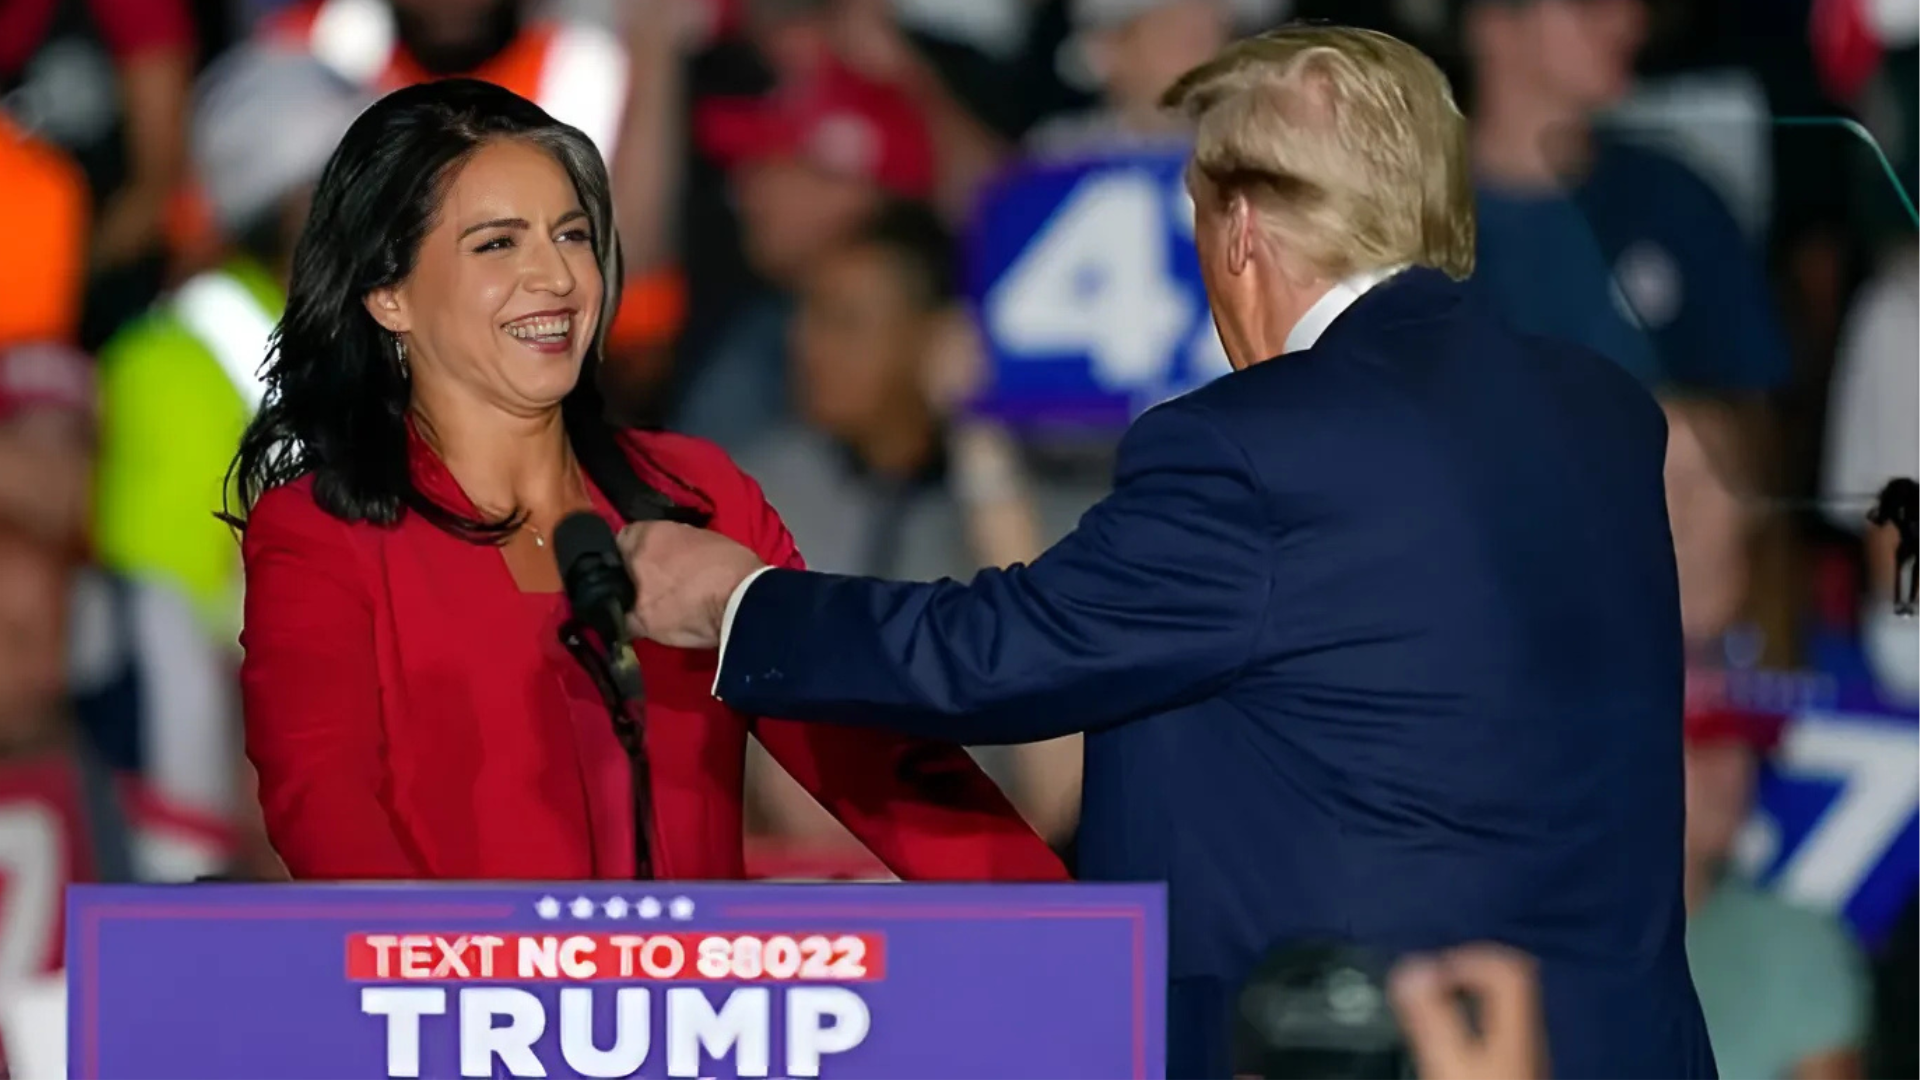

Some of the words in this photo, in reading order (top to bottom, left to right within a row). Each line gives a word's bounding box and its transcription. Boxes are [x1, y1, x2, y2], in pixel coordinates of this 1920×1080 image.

[366, 936, 503, 977] TEXT
[518, 936, 597, 978] NC
[610, 936, 685, 978] TO
[361, 987, 870, 1077] TRUMP
